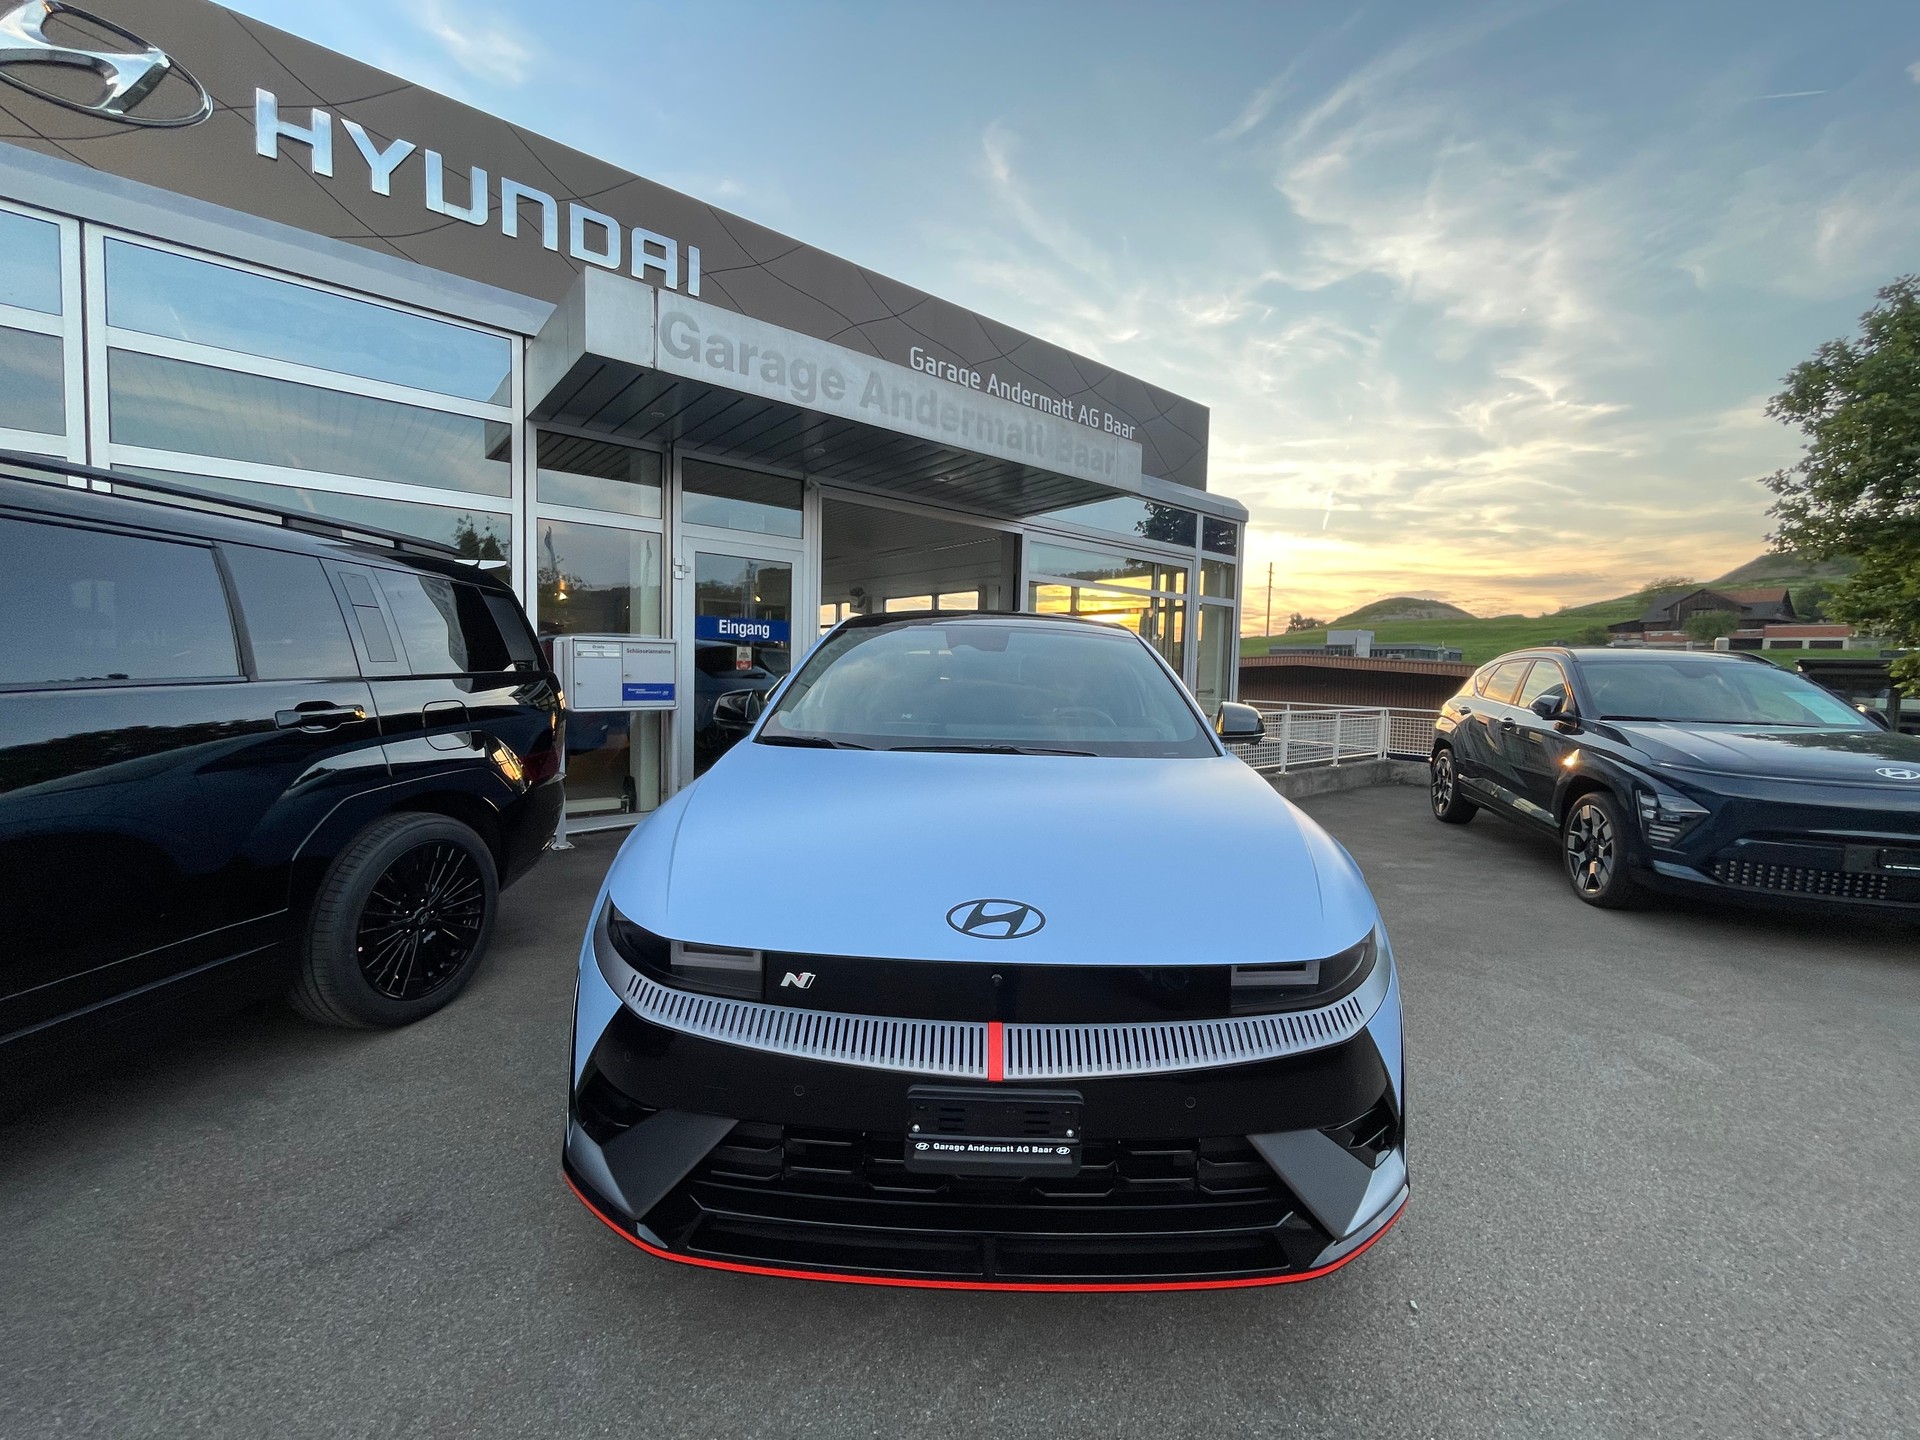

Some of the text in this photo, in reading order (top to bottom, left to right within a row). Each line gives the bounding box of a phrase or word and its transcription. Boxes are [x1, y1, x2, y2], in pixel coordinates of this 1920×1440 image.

[256, 88, 700, 298] HYUNDAI
[659, 311, 846, 404] Garage
[860, 371, 1044, 457] Andermatt
[910, 346, 1136, 440] Garage Andermatt AG Baar
[719, 619, 770, 639] Eingang
[933, 1142, 965, 1152] Garage
[967, 1144, 1014, 1153] Andermatt
